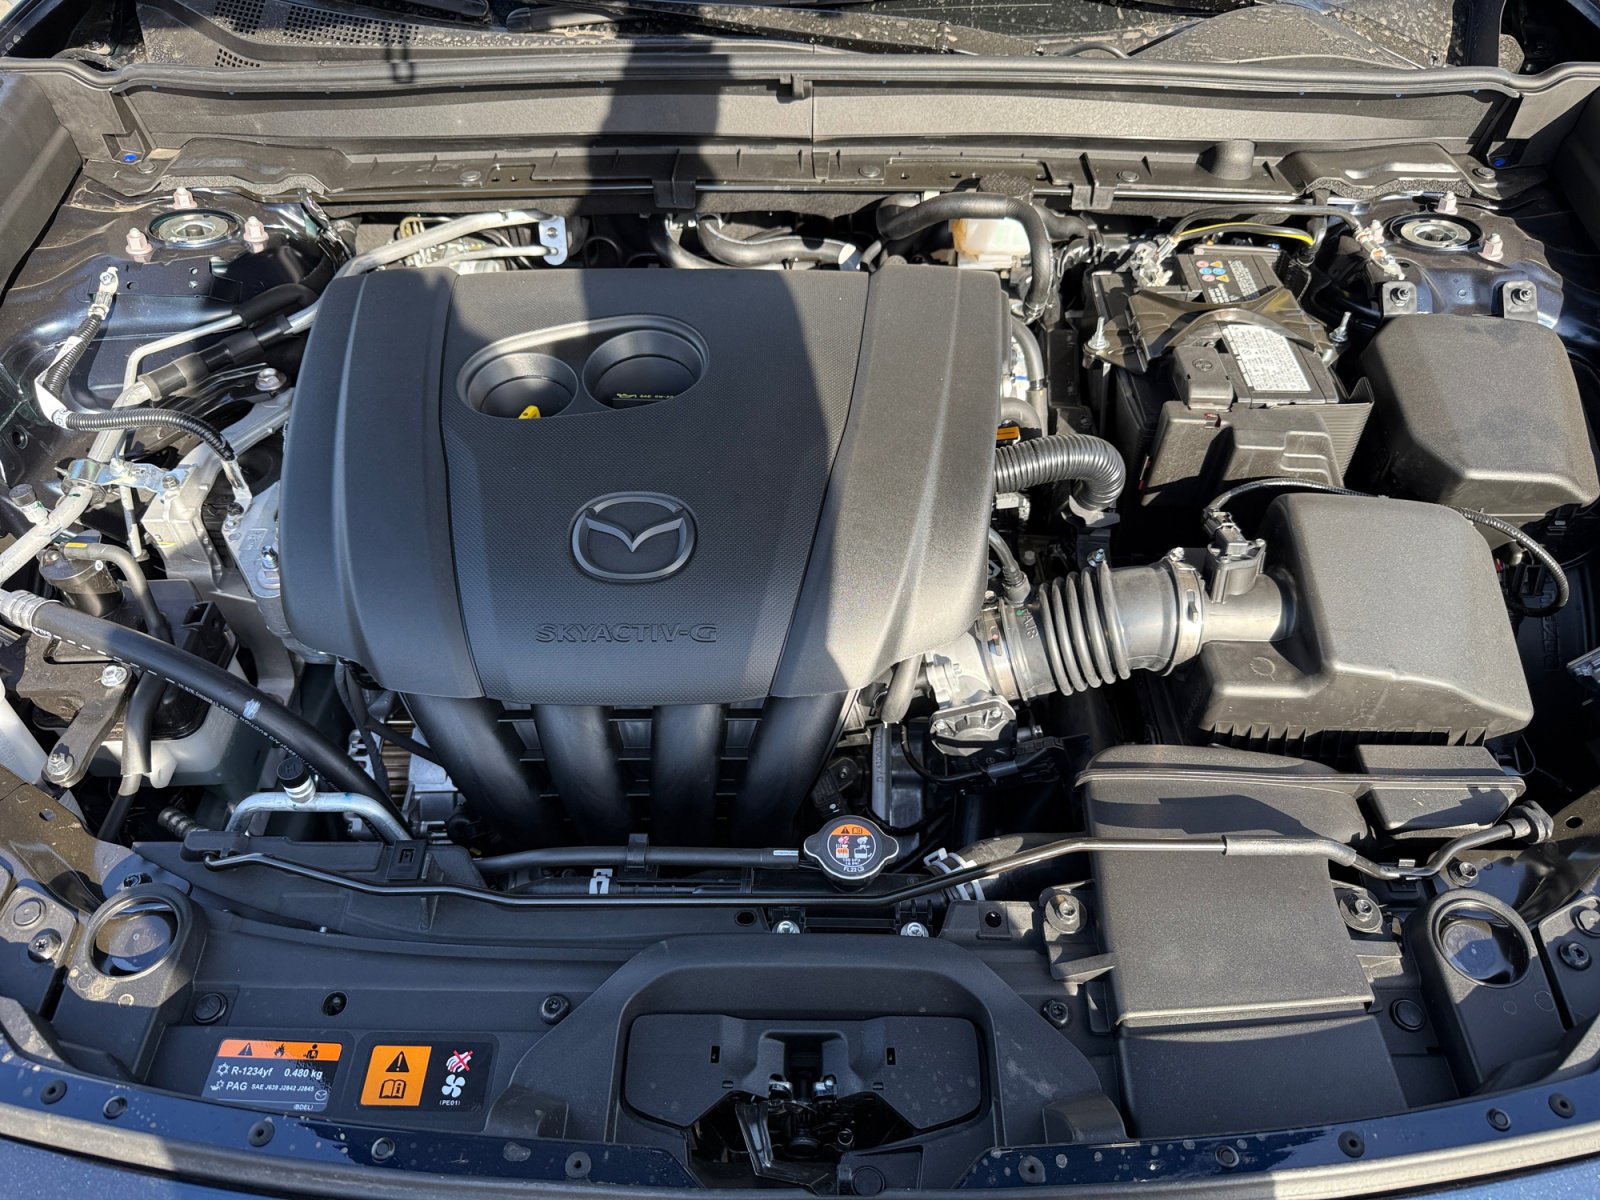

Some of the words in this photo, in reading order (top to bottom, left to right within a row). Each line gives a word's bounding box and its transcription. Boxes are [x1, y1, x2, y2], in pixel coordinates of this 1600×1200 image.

[535, 622, 718, 643] SKYACTIV-G
[230, 1066, 274, 1078] R-1234yf
[284, 1068, 309, 1078] 0.480
[310, 1069, 323, 1080] kg
[225, 1081, 248, 1091] PAG
